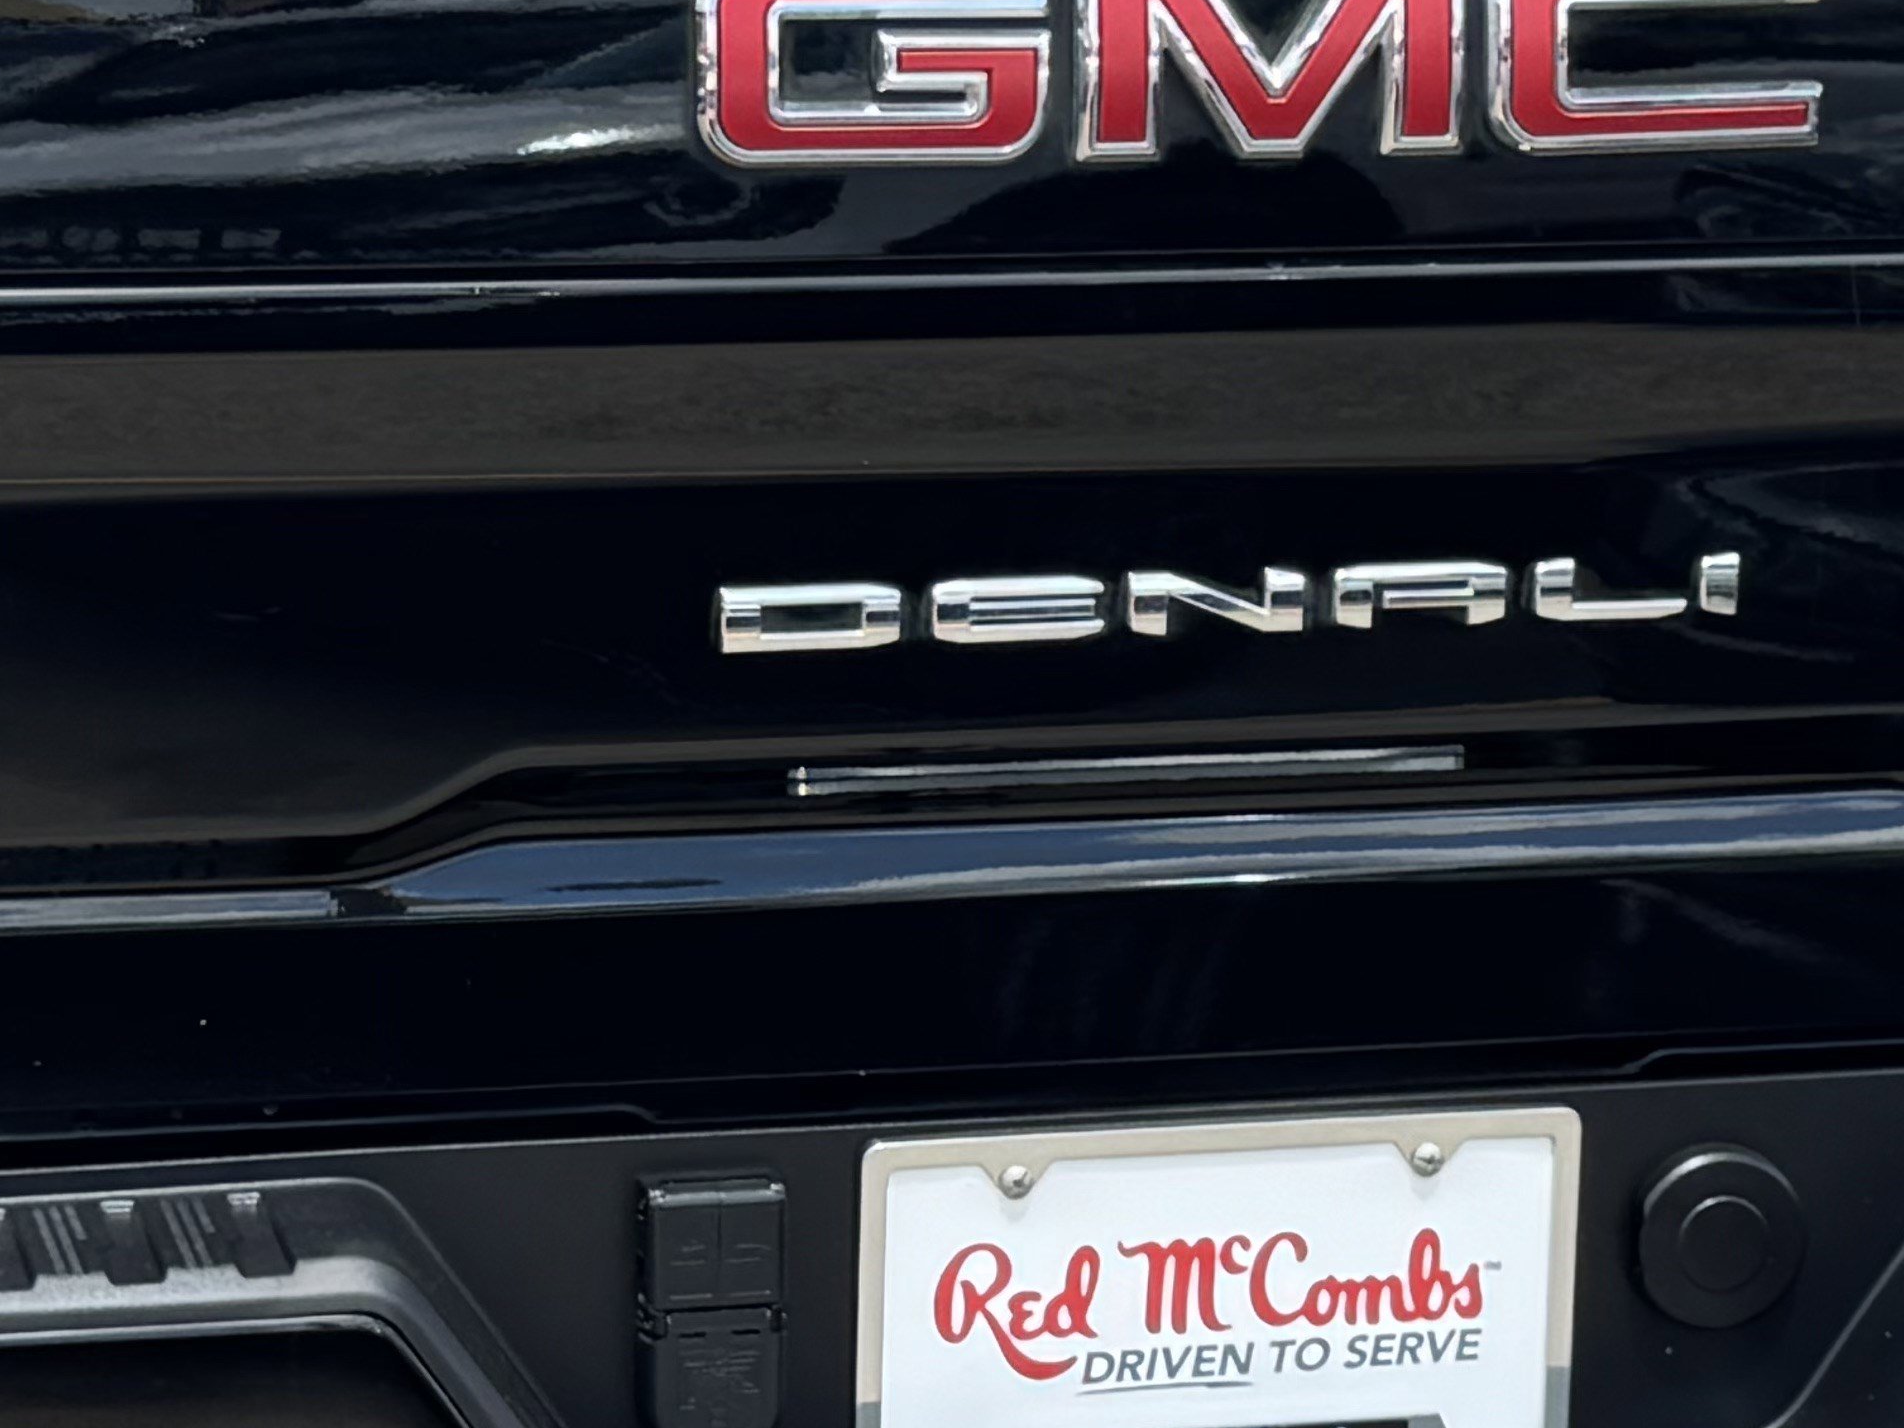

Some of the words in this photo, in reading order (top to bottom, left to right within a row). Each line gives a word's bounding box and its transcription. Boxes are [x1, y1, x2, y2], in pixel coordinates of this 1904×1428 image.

[719, 552, 1741, 654] DENALI
[934, 1243, 1100, 1381] Red
[1117, 1228, 1483, 1335] McCombs
[1082, 1342, 1254, 1385] DRIVEN
[1270, 1337, 1331, 1373] TO
[1343, 1328, 1482, 1369] SERVE
